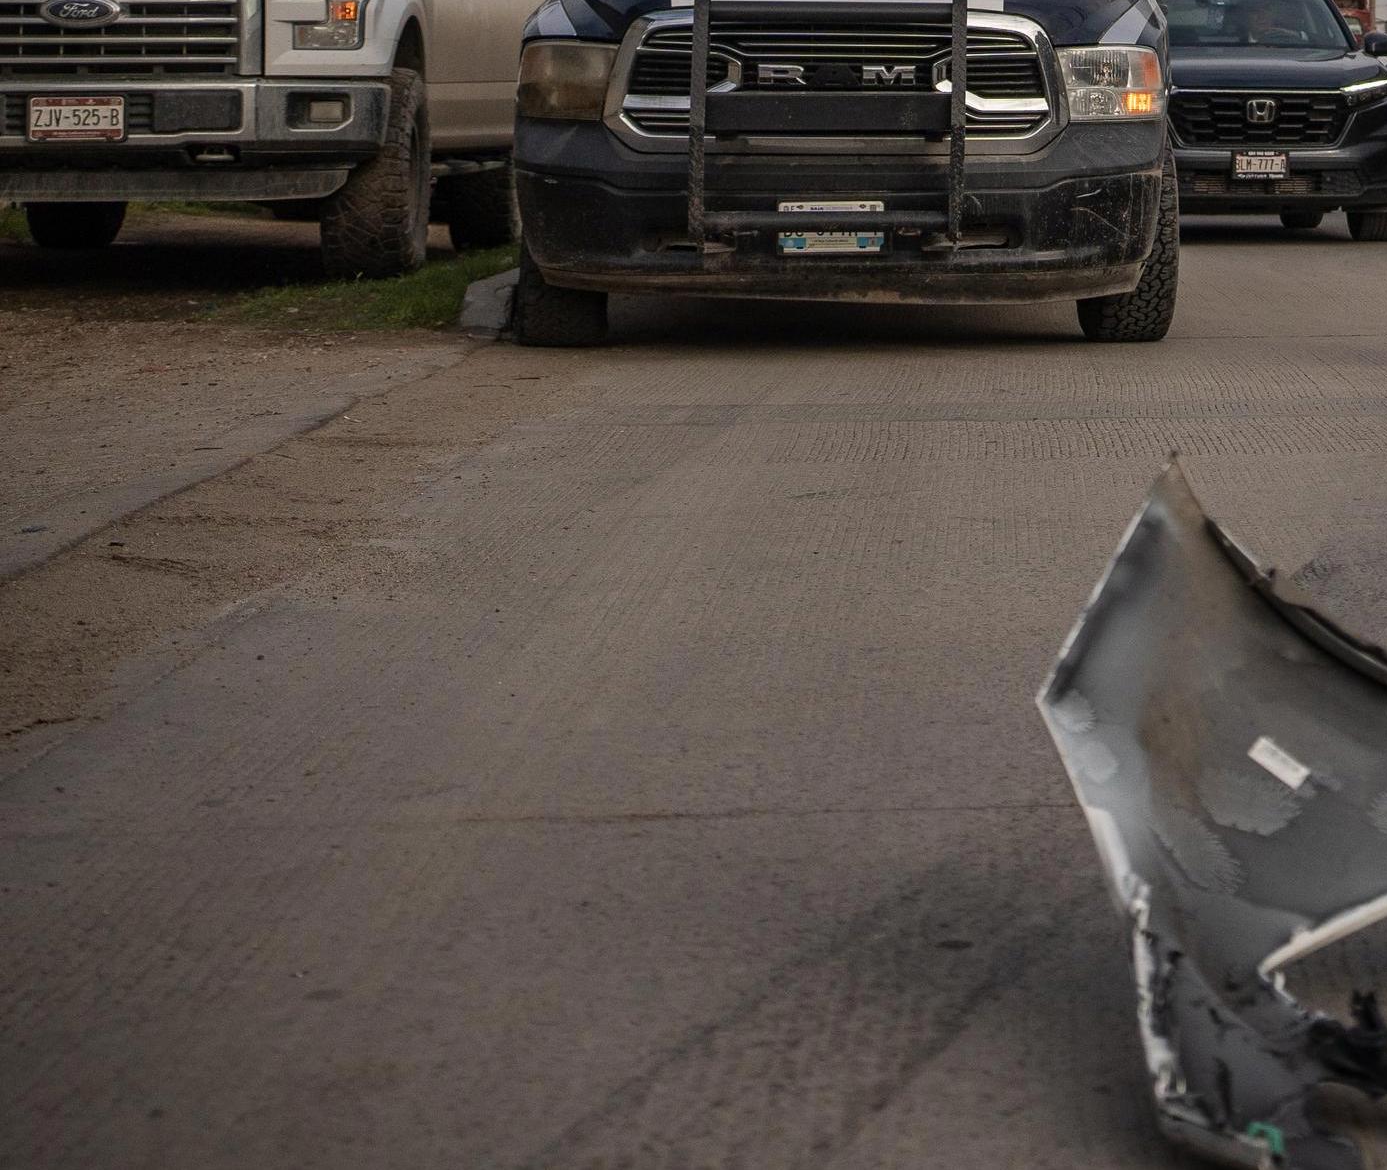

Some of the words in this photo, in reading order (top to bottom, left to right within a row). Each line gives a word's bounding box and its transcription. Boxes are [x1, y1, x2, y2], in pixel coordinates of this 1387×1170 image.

[60, 3, 99, 17] Ford
[757, 64, 916, 85] RAM
[33, 108, 120, 128] ZJV-525-B
